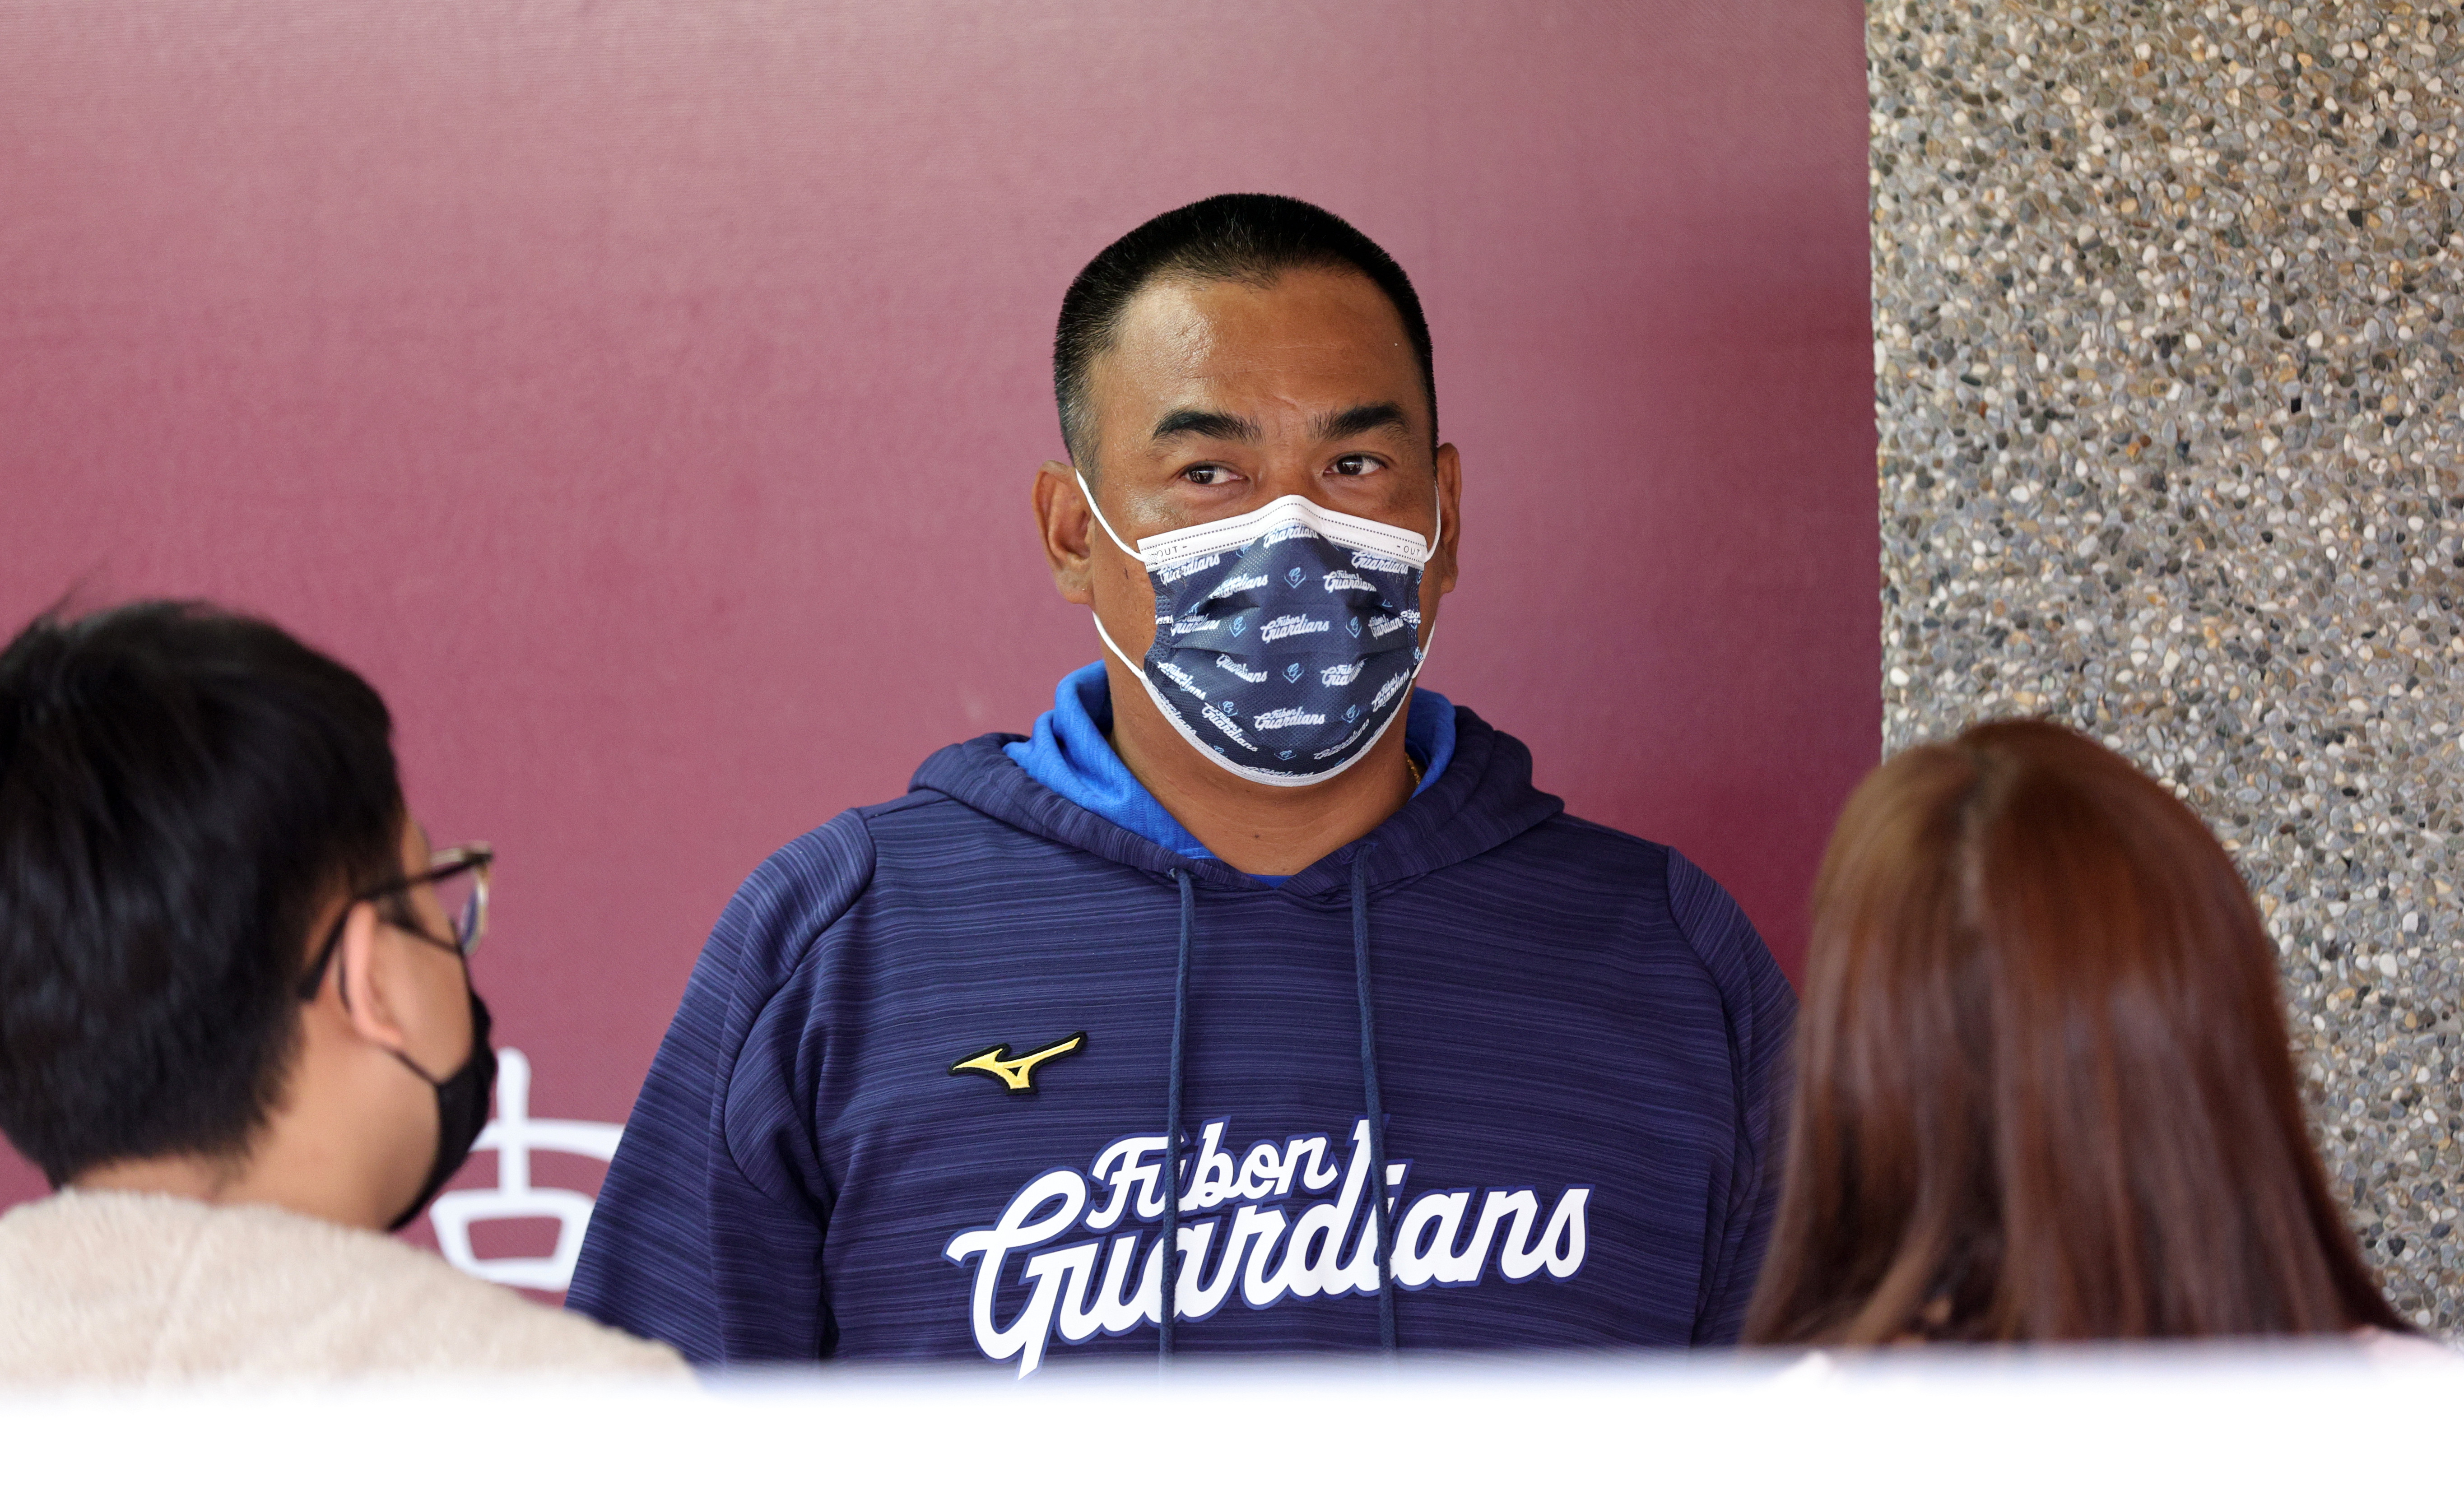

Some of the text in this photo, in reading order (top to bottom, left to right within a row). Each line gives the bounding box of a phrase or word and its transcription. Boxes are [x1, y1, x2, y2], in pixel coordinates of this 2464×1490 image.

[1157, 546, 1177, 557] OUT
[1404, 545, 1420, 556] OUT
[1260, 613, 1330, 644] Guardians
[1276, 614, 1301, 628] Fubon
[1253, 706, 1326, 731] Guardians
[1269, 707, 1297, 719] Fubon
[1201, 702, 1258, 752] Guardians
[1086, 1120, 1338, 1230] Fubon
[946, 1118, 1589, 1381] Guardians
